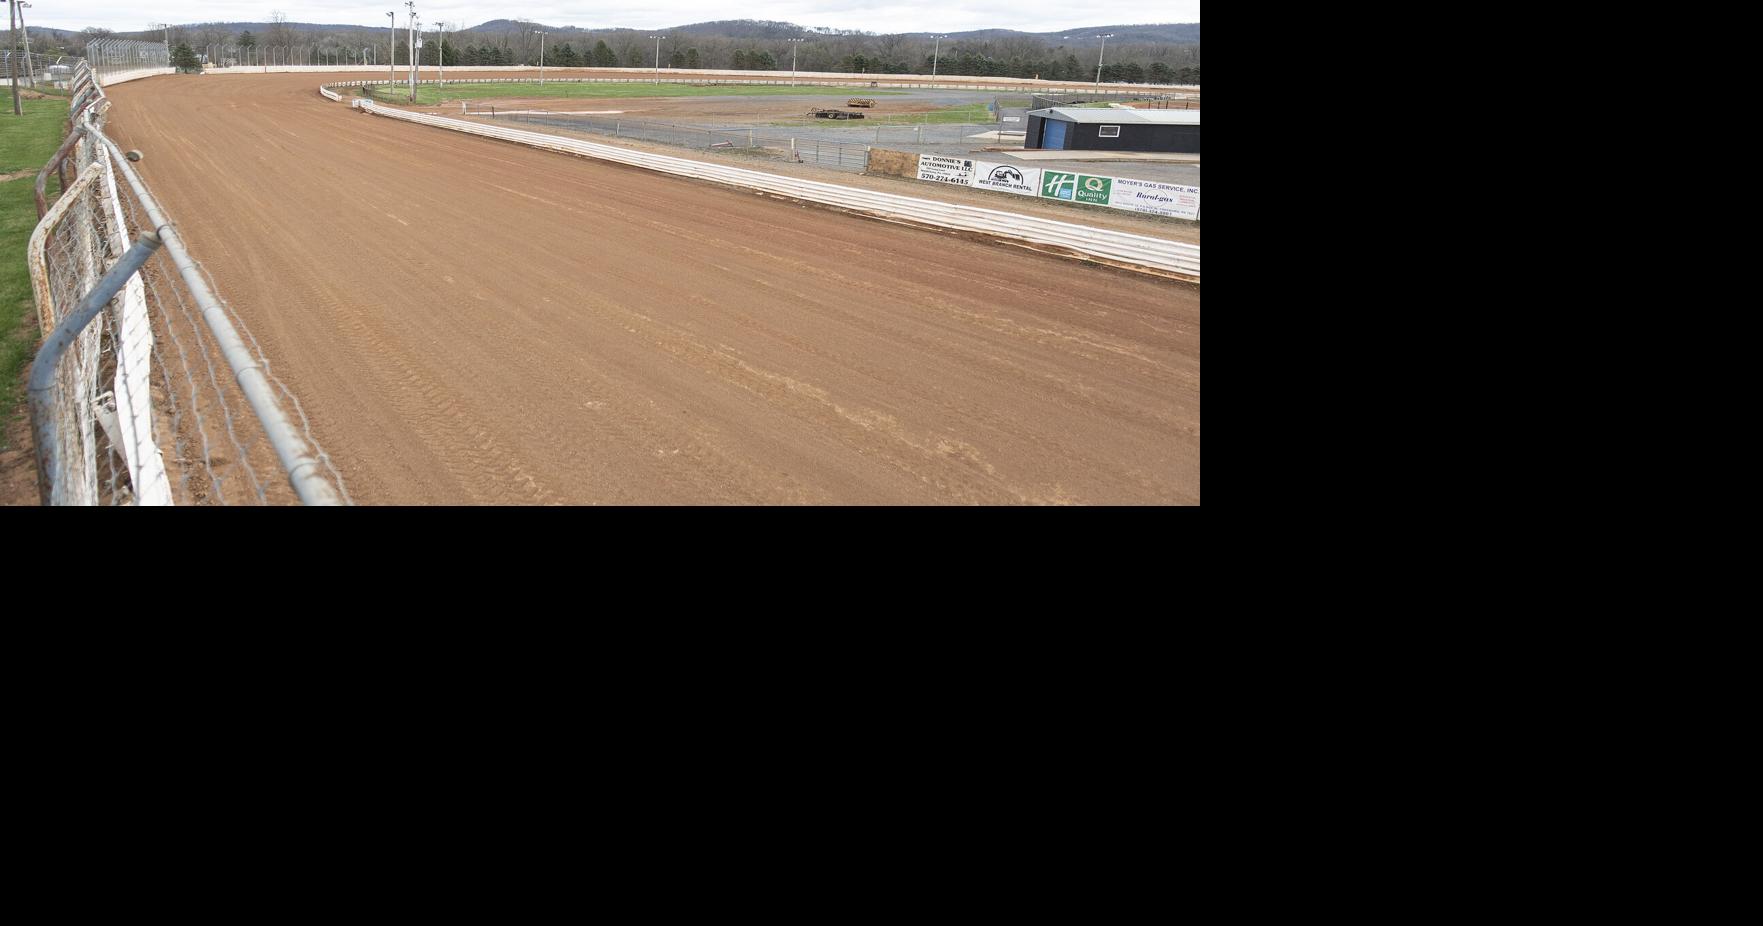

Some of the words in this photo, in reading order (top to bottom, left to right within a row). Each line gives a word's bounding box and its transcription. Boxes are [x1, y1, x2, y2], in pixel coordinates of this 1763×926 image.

[920, 162, 960, 170] AUTOMOTIVE
[1085, 178, 1104, 191] Q
[1078, 190, 1107, 200] Quality
